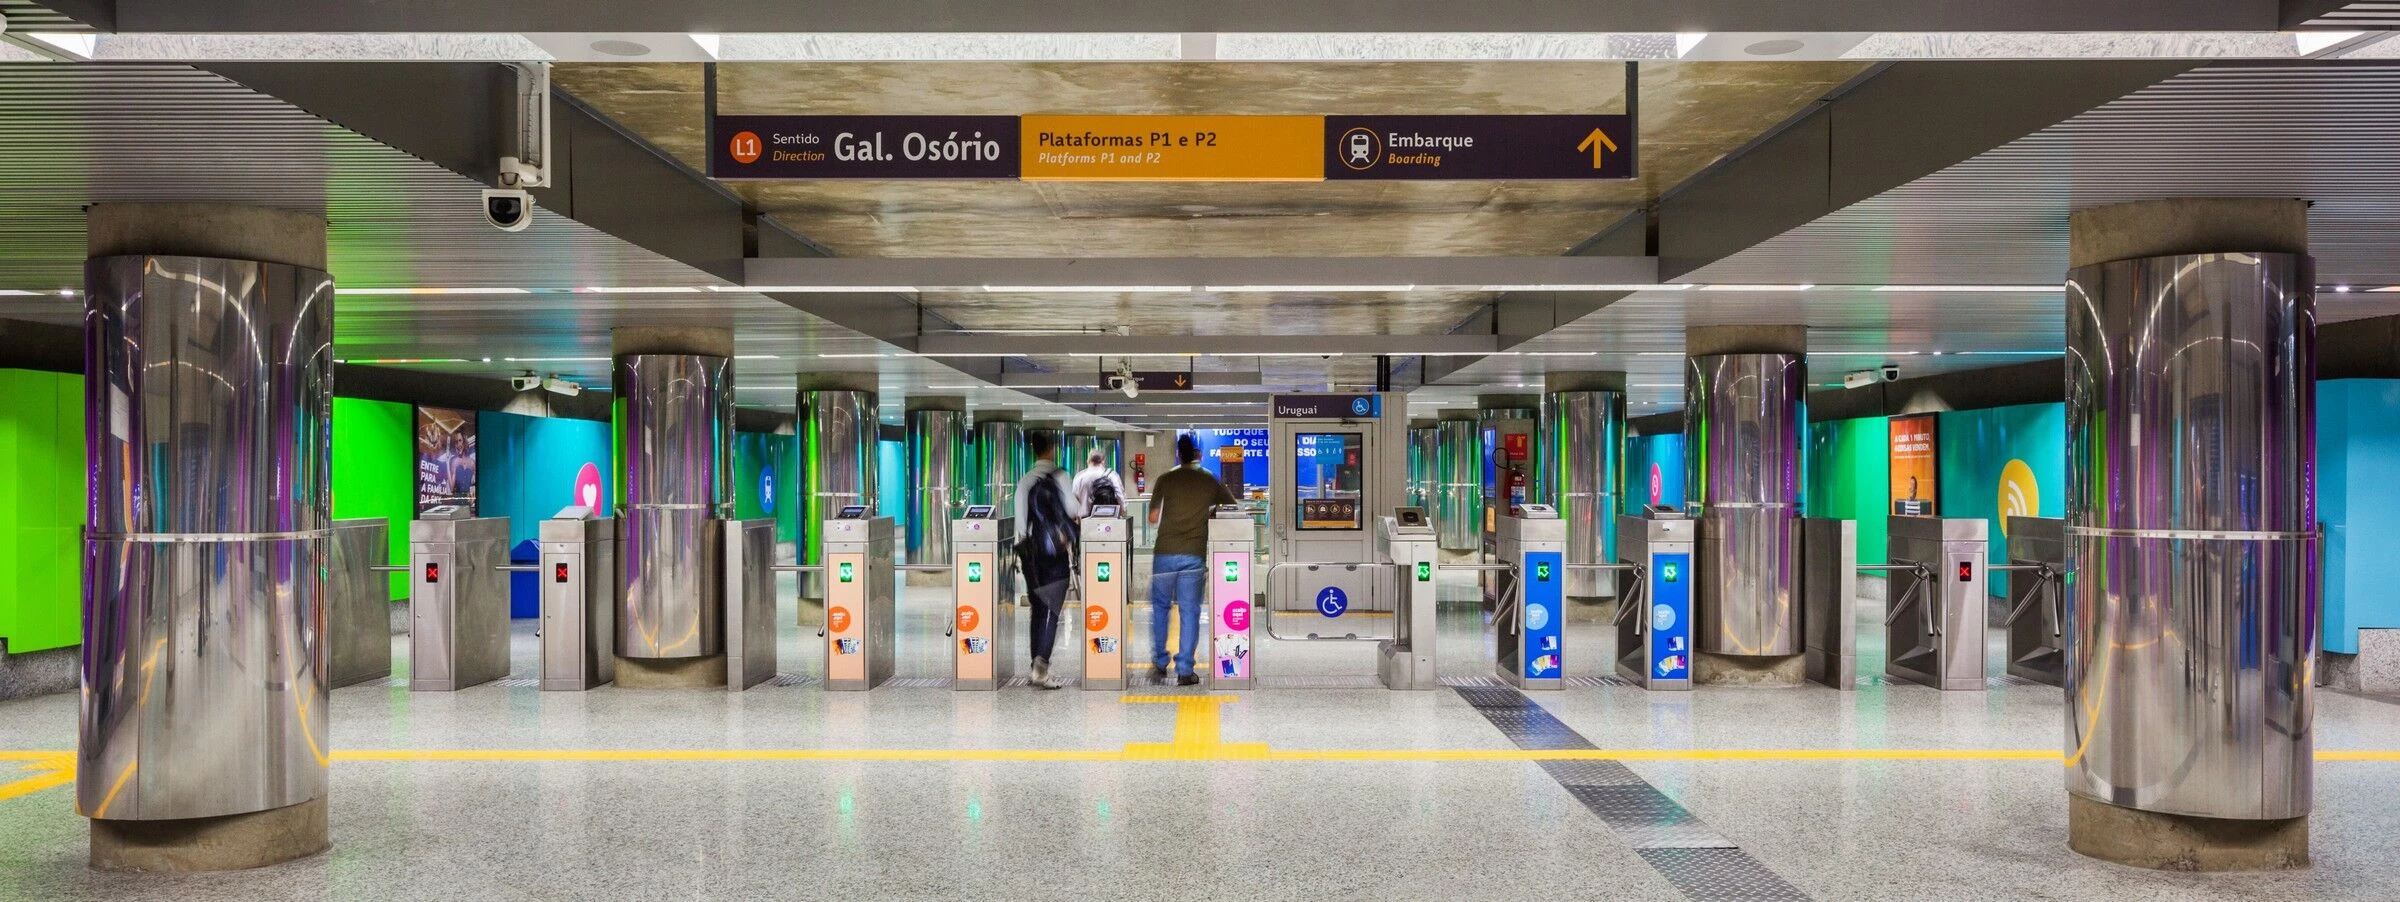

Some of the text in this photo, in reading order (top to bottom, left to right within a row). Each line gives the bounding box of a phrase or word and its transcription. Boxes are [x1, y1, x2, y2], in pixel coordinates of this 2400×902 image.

[773, 133, 820, 145] Sentido
[1039, 132, 1217, 147] Plataformas P1 e P2
[1389, 132, 1474, 152] Embarque
[736, 138, 756, 156] L1
[834, 131, 1001, 161] Gal. Osório
[773, 150, 826, 161] Direction
[1039, 152, 1161, 166] Platforms P1 and P2
[1388, 153, 1441, 167] Boarding
[1278, 405, 1317, 416] Uruguai
[1212, 428, 1264, 436] TUDO QUE
[1233, 438, 1249, 446] DO
[421, 460, 439, 474] ENTRE
[421, 471, 436, 483] PARA
[420, 482, 426, 492] A
